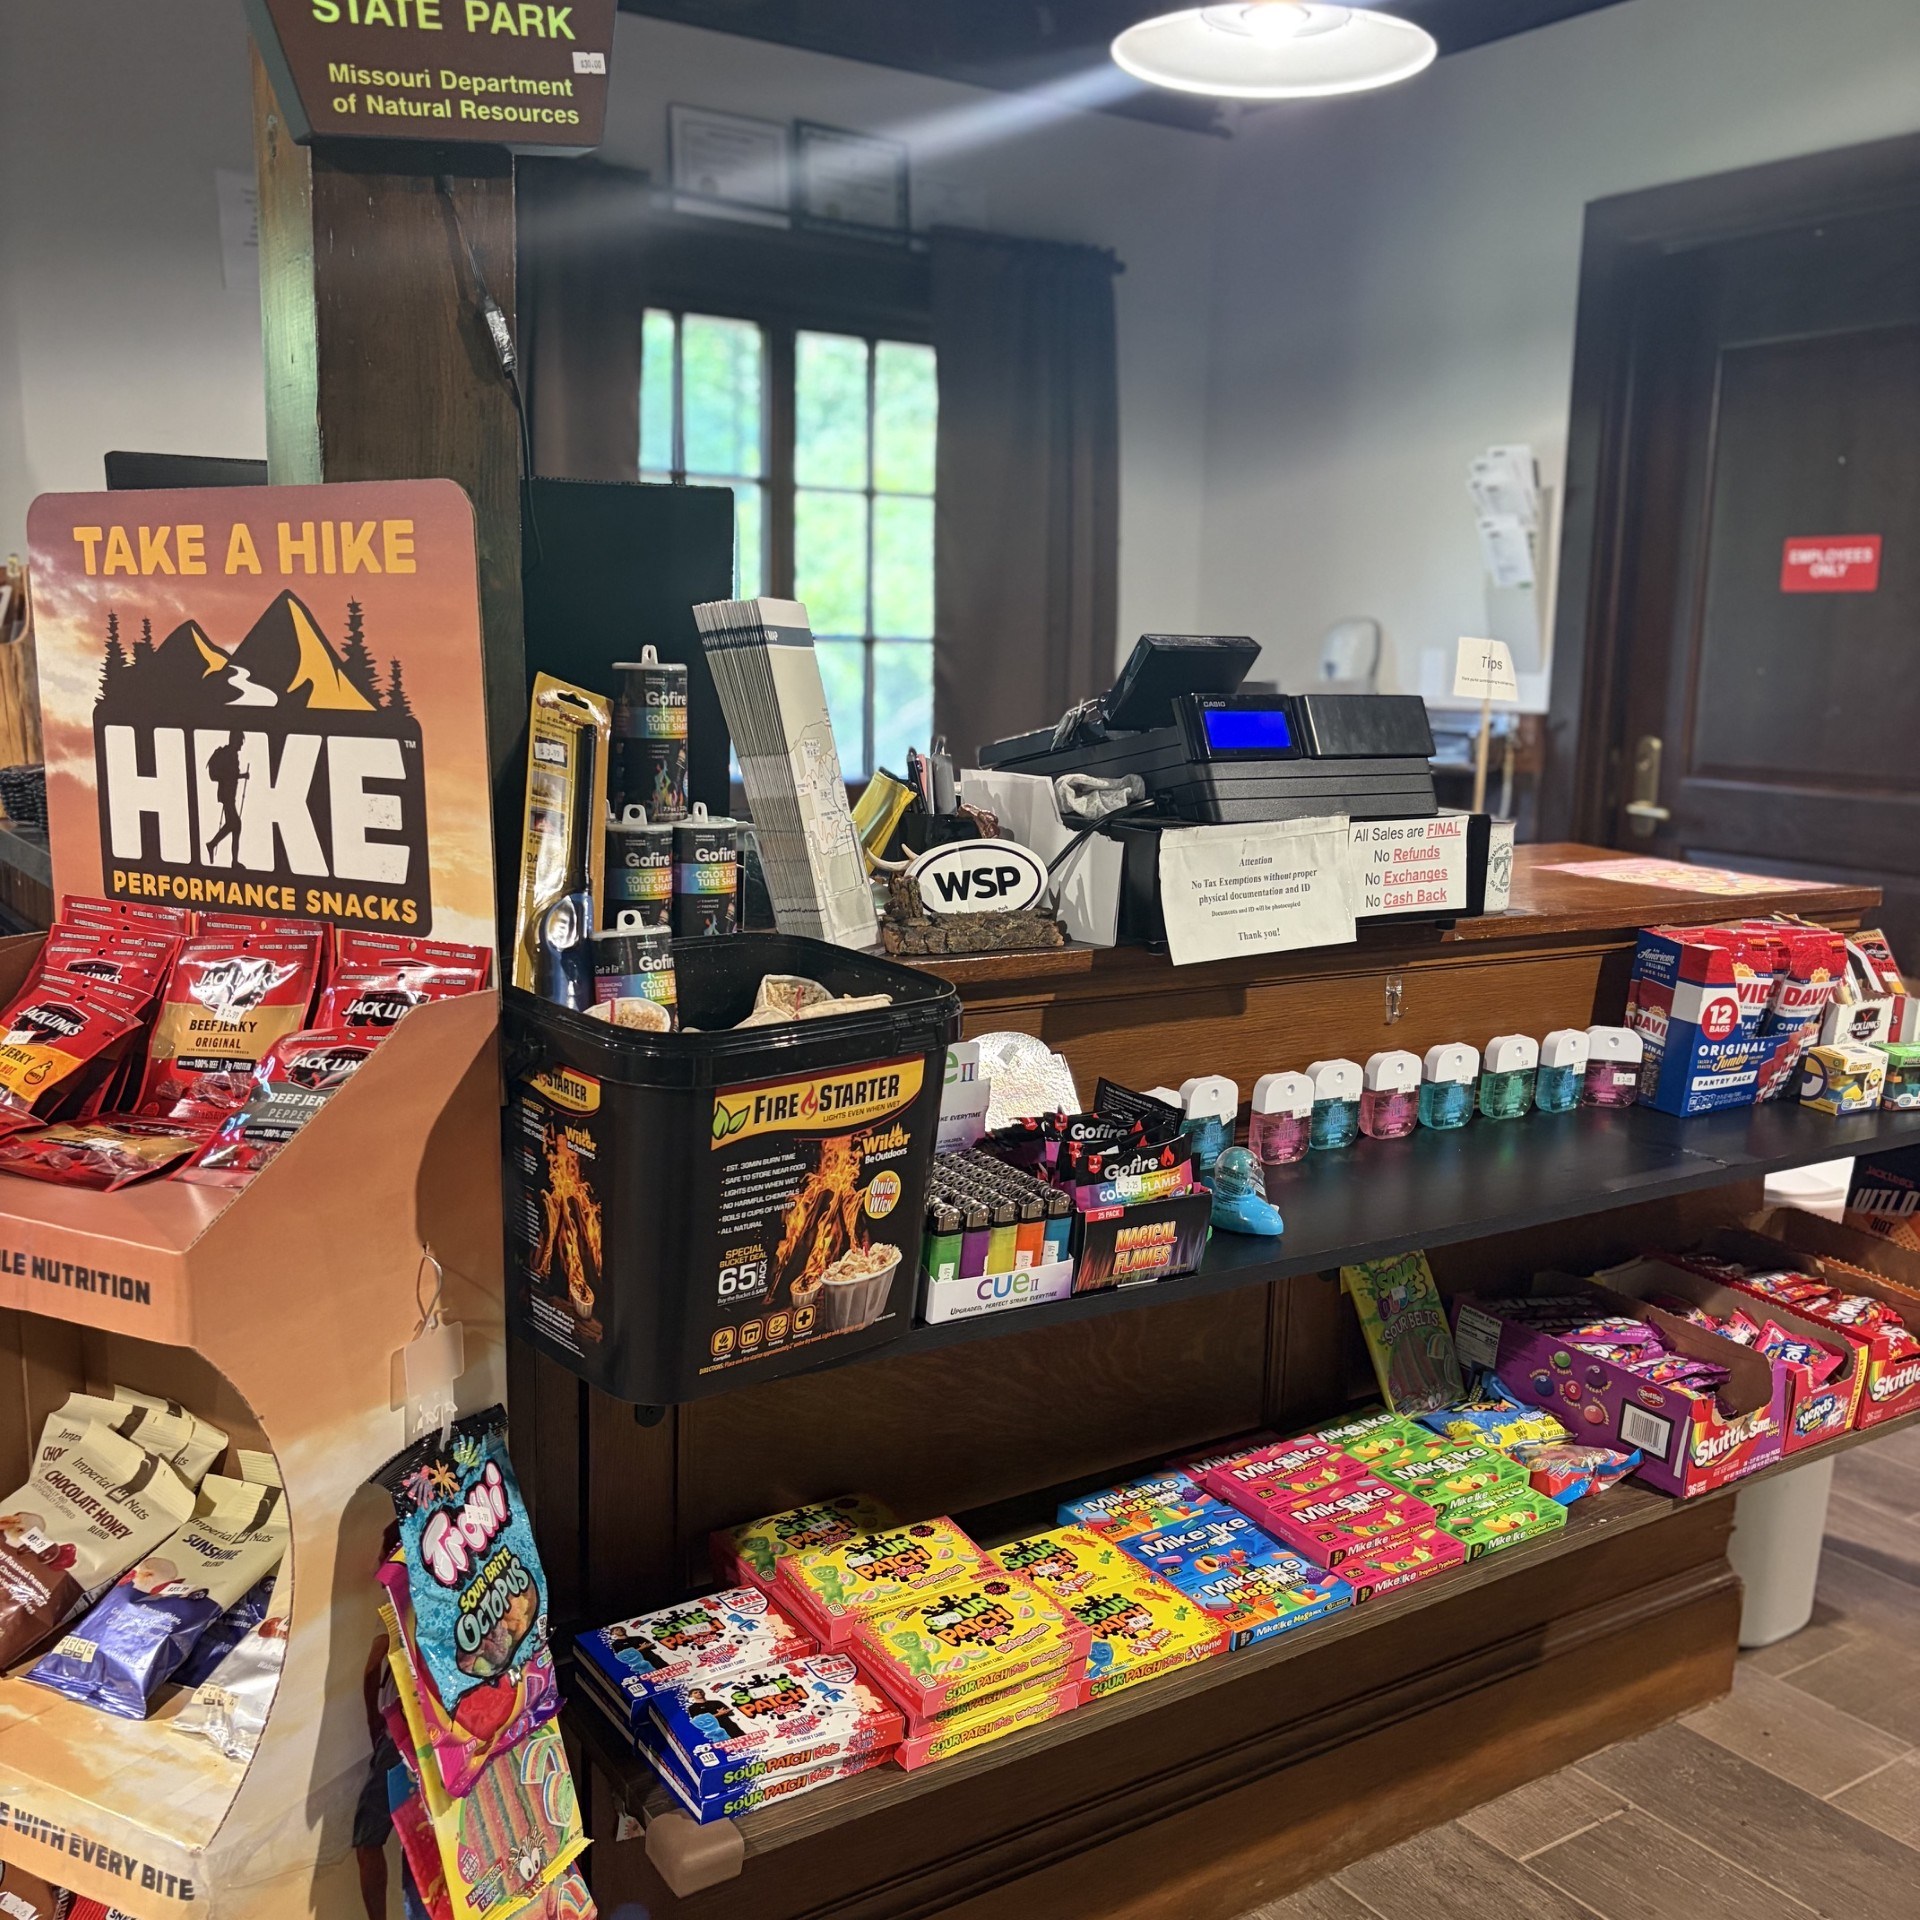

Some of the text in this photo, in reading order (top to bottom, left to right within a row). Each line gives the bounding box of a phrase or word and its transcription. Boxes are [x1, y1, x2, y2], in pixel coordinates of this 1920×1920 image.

[312, 0, 575, 40] STATE PARK
[329, 63, 574, 96] Missouri Department
[333, 95, 579, 124] of Natural Resources
[73, 519, 416, 575] TAKE A HIKE
[1788, 547, 1874, 565] EMPLOYEES
[1810, 563, 1847, 579] ONLY
[1482, 656, 1503, 671] Tips
[646, 692, 687, 706] Gofire
[646, 715, 675, 723] COLOR
[649, 723, 670, 731] TUBE
[104, 724, 411, 884] HIKE
[1354, 822, 1461, 842] All Sales are FINAL
[626, 853, 670, 867] Gofire
[695, 848, 735, 862] Gofire
[1239, 857, 1272, 867] Attention
[1374, 845, 1440, 863] No Refunds
[626, 876, 655, 884] COLOR
[696, 871, 724, 879] COLOR
[698, 878, 720, 886] TUBE
[933, 866, 1021, 902] WSP
[1192, 869, 1318, 889] No Tax Exemptions without proper
[1365, 867, 1448, 886] No Exchanges
[113, 870, 417, 923] PERFORMANCE SNACKS
[628, 884, 650, 892] TUBE
[1199, 883, 1310, 906] physical documentation and ID
[1366, 887, 1447, 908] No Cash Back
[1238, 927, 1280, 940] Thank you!
[1638, 949, 1675, 966] American
[641, 981, 666, 989] COLOR
[644, 990, 665, 998] TUBE
[342, 1000, 382, 1017] JACK
[1710, 1005, 1732, 1024] 12
[189, 1020, 257, 1032] BEEF JERKY
[1635, 1013, 1667, 1037] DAVI
[1709, 1025, 1730, 1033] BAGS
[196, 1038, 241, 1048] ORIGINAL
[1698, 1042, 1766, 1056] ORIGINAL
[1, 1047, 35, 1065] JERKY
[286, 1056, 328, 1071] JACK
[1712, 1054, 1749, 1072] Jumbo
[1698, 1074, 1752, 1087] PANTRY PACK
[269, 1093, 301, 1104] BEEF
[754, 1075, 900, 1124] FIRE STARTER
[823, 1104, 885, 1122] LIGHTS EVEN WHEN
[950, 1111, 982, 1121] EVERYTIME
[565, 1126, 596, 1151] Wilcor
[1071, 1123, 1128, 1140] Gofire
[863, 1132, 910, 1155] Wilcor
[865, 1148, 907, 1164] Be Outdoors
[1104, 1157, 1158, 1180] Gofire
[1141, 1174, 1181, 1192] FLAMES
[1852, 1188, 1920, 1216] WILD
[1106, 1210, 1120, 1219] PACK
[1115, 1221, 1177, 1252] MAGICAL
[720, 1252, 767, 1268] BUCKET DEAL
[725, 1244, 763, 1259] SPECIAL
[1113, 1245, 1171, 1274] FLAMES
[32, 1256, 150, 1305] NUTRITION
[719, 1263, 756, 1295] 65
[758, 1260, 768, 1286] PACK
[1376, 1256, 1416, 1298] SOUR
[985, 1301, 1008, 1309] PERFECT
[1385, 1311, 1438, 1344] SOUR BELTS
[1484, 1337, 1498, 1346] 250
[1872, 1360, 1920, 1402] Skittle
[1231, 1458, 1291, 1482] Mike
[1392, 1458, 1451, 1481] Mike
[1688, 1483, 1697, 1496] 36
[45, 1471, 133, 1540] CHOCOLATE HONEY
[125, 1499, 149, 1520] Nuts
[1083, 1488, 1143, 1512] Mike
[1106, 1498, 1157, 1518] Mega
[1450, 1494, 1474, 1509] Mike
[1290, 1498, 1352, 1524] Mike
[190, 1518, 274, 1543] Imperial Nuts
[775, 1510, 840, 1537] SOUR
[183, 1534, 243, 1561] SUNSHINE
[1138, 1528, 1207, 1557] Mike
[1347, 1540, 1372, 1556] Mike
[1488, 1534, 1512, 1549] Mike
[855, 1545, 932, 1581] PATCH
[1003, 1543, 1061, 1569] SOUR
[1201, 1569, 1262, 1598] Mike
[1224, 1581, 1280, 1604] Mega
[1375, 1578, 1400, 1593] Mike
[461, 1577, 486, 1613] SOUR
[729, 1592, 763, 1609] WIN
[1077, 1597, 1135, 1625] SOUR
[651, 1612, 709, 1638] SOUR
[937, 1606, 1014, 1645] PATCH
[996, 1623, 1051, 1652] Watermelon
[816, 1661, 851, 1674] WIN
[946, 1668, 1009, 1700] SOUR PATCH
[1091, 1661, 1161, 1695] SOUR PATCH
[738, 1685, 810, 1717] PATCH
[713, 1730, 769, 1749] CHRISTIAN
[725, 1738, 766, 1752] PULISIC
[929, 1723, 994, 1754] SOUR PATCH
[702, 1753, 714, 1761] 110
[723, 1751, 811, 1784] SOUR PATCH
[723, 1775, 808, 1814] SOUR PATCH
[15, 1808, 195, 1901] WITH EVERY BITE
